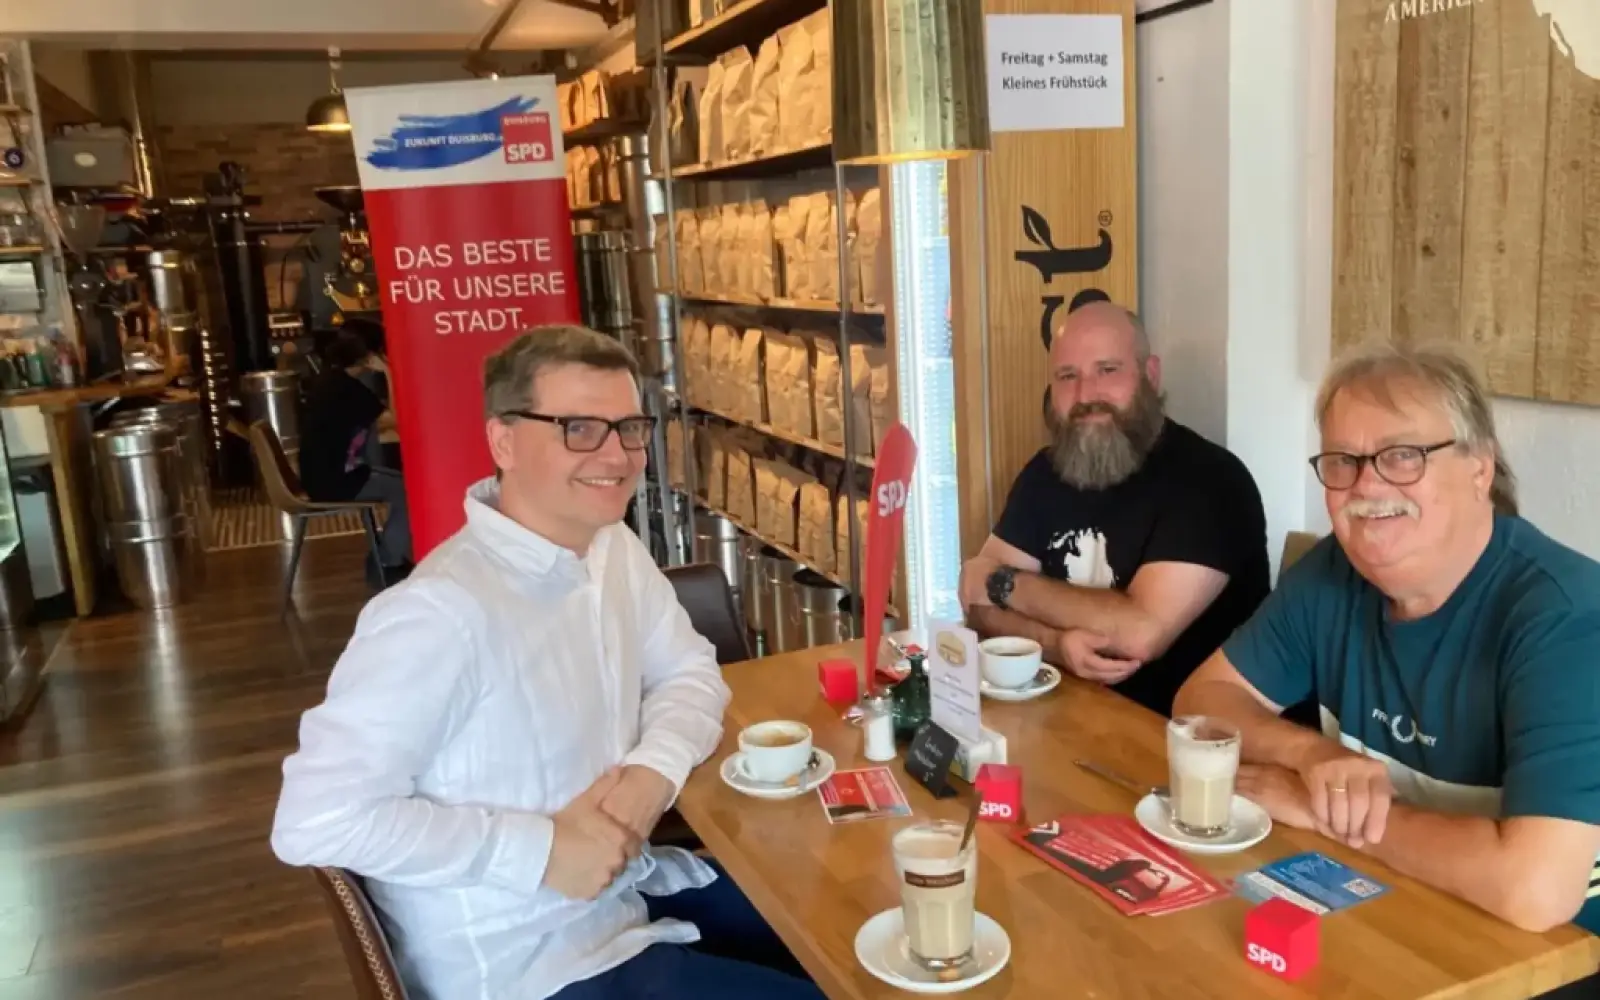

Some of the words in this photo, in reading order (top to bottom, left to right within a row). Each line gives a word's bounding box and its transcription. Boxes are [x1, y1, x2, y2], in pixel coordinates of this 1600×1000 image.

[1001, 52, 1045, 67] Freitag
[1057, 51, 1108, 67] Samstag
[1002, 76, 1046, 90] Kleines
[1050, 75, 1108, 90] Frühstück
[507, 143, 546, 161] SPD
[394, 244, 452, 270] DAS
[463, 239, 552, 266] BESTE
[389, 275, 445, 304] FÜR
[453, 271, 565, 301] UNSERE
[435, 307, 528, 335] STADT.
[877, 480, 906, 517] SPD
[978, 801, 1013, 818] SPD
[1247, 943, 1288, 973] SPD
